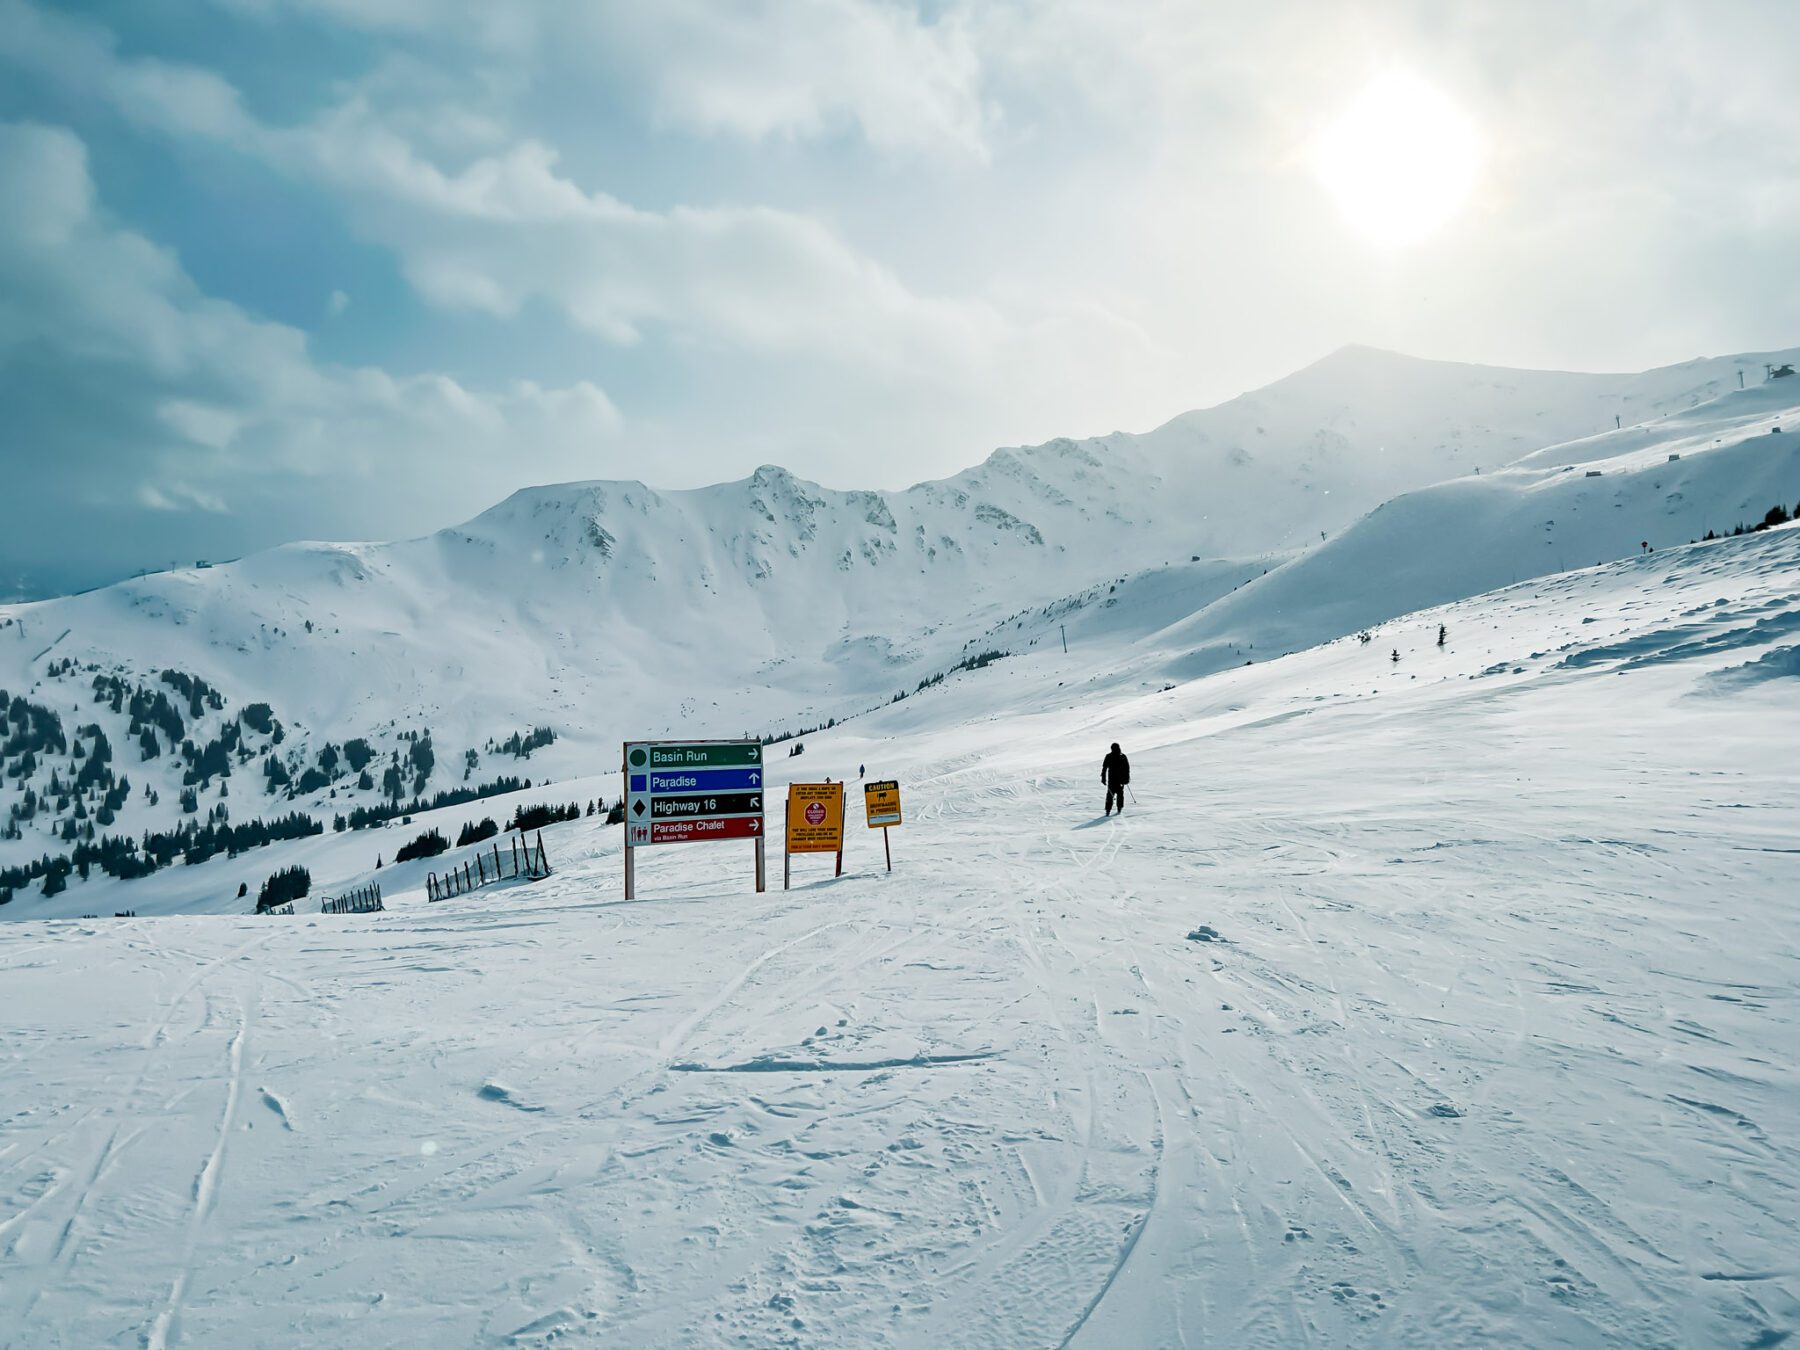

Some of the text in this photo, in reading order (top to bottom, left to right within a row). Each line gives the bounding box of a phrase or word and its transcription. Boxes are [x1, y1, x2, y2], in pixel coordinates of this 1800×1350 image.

[653, 751, 707, 762] Basin Run
[652, 776, 697, 788] Paradise
[868, 782, 895, 792] CAUTION
[654, 799, 716, 815] Highway 16
[653, 820, 725, 833] Paradise Chalet
